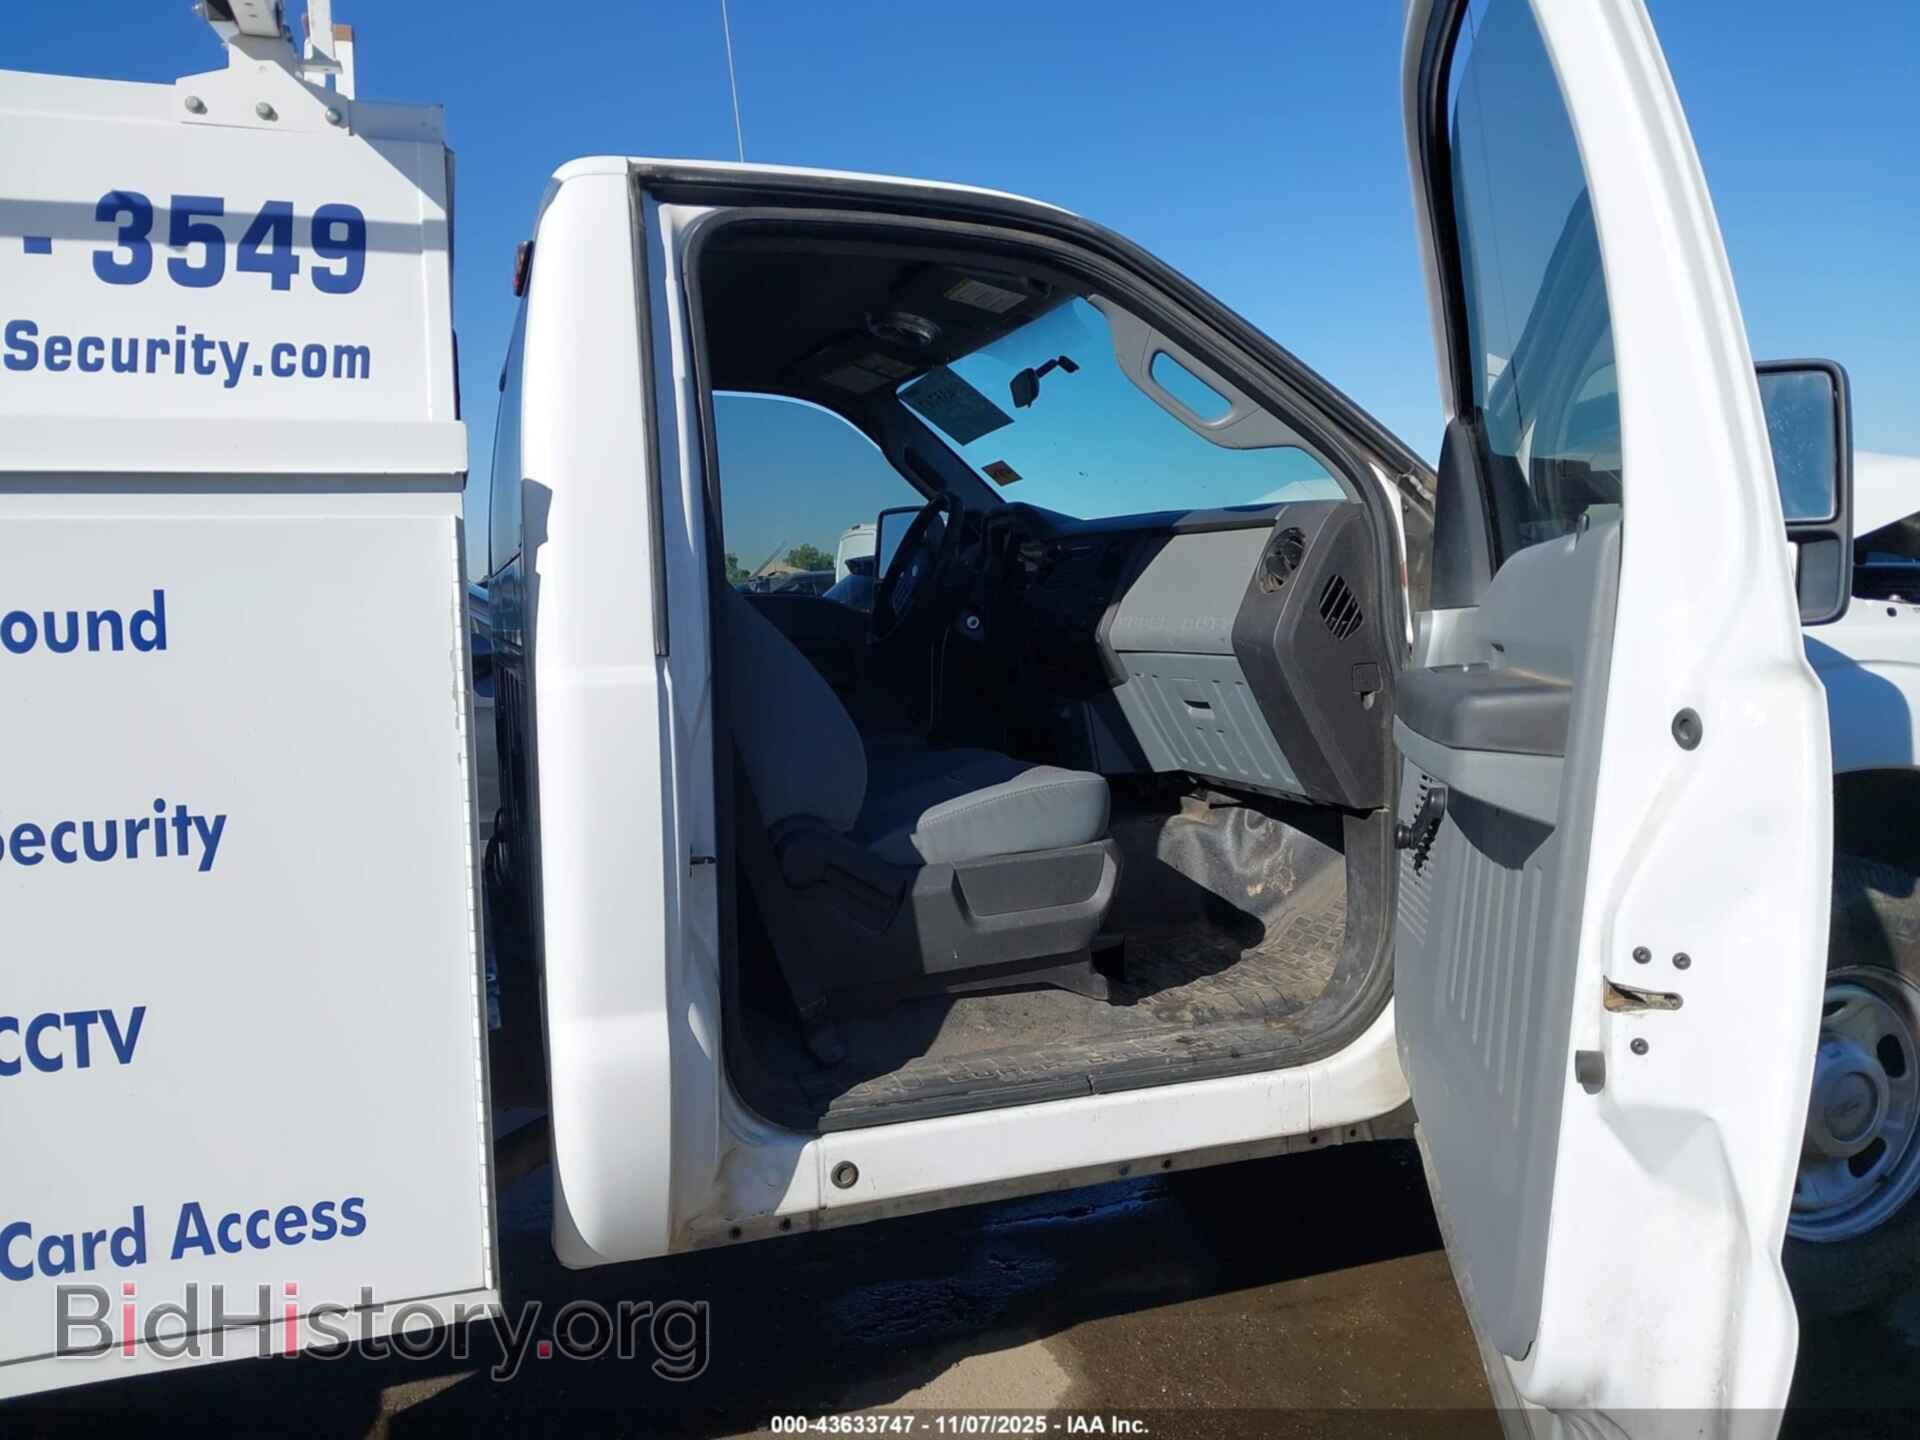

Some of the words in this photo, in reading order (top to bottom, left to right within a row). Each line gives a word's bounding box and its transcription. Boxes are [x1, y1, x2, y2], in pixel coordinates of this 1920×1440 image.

[93, 191, 368, 294] 3549
[3, 319, 370, 388] Security.com
[0, 590, 167, 654] ound
[0, 798, 227, 872] ecurity
[0, 1006, 146, 1077] CCTV
[0, 1206, 147, 1281] Card
[171, 1196, 367, 1260] Access
